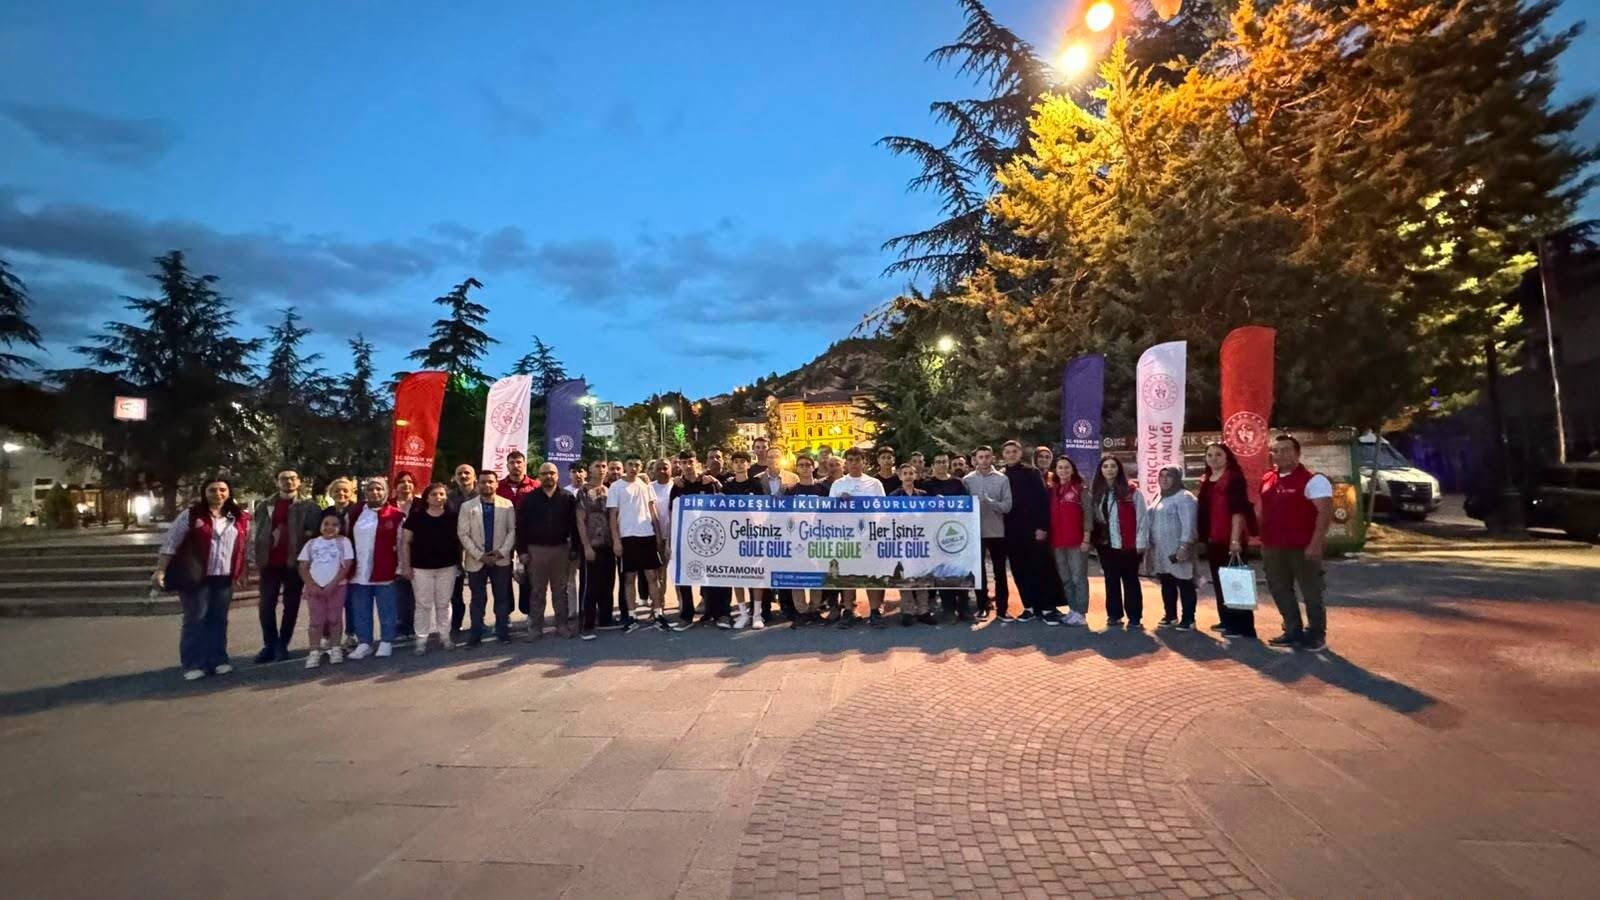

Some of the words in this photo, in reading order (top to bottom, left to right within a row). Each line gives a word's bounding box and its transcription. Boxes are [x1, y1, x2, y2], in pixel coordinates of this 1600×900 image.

[1148, 425, 1158, 441] VE
[1145, 442, 1160, 494] GENÇLİK
[684, 497, 704, 507] BİR
[710, 497, 786, 510] KARDEŞLİK
[793, 497, 855, 509] İKLİMİNE
[863, 498, 970, 509] UĞURLUYORUZ.
[730, 518, 782, 539] Gelişiniz
[799, 519, 855, 540] Gidişiniz
[869, 521, 890, 541] Her
[892, 518, 925, 541] İşiniz
[739, 538, 764, 557] GÜLE
[766, 538, 792, 558] GÜLE
[808, 538, 834, 558] GÜLE
[835, 538, 862, 558] GÜLE
[877, 538, 903, 558] GÜLE
[905, 538, 930, 558] GÜLE
[706, 565, 765, 575] KASTAMONU
